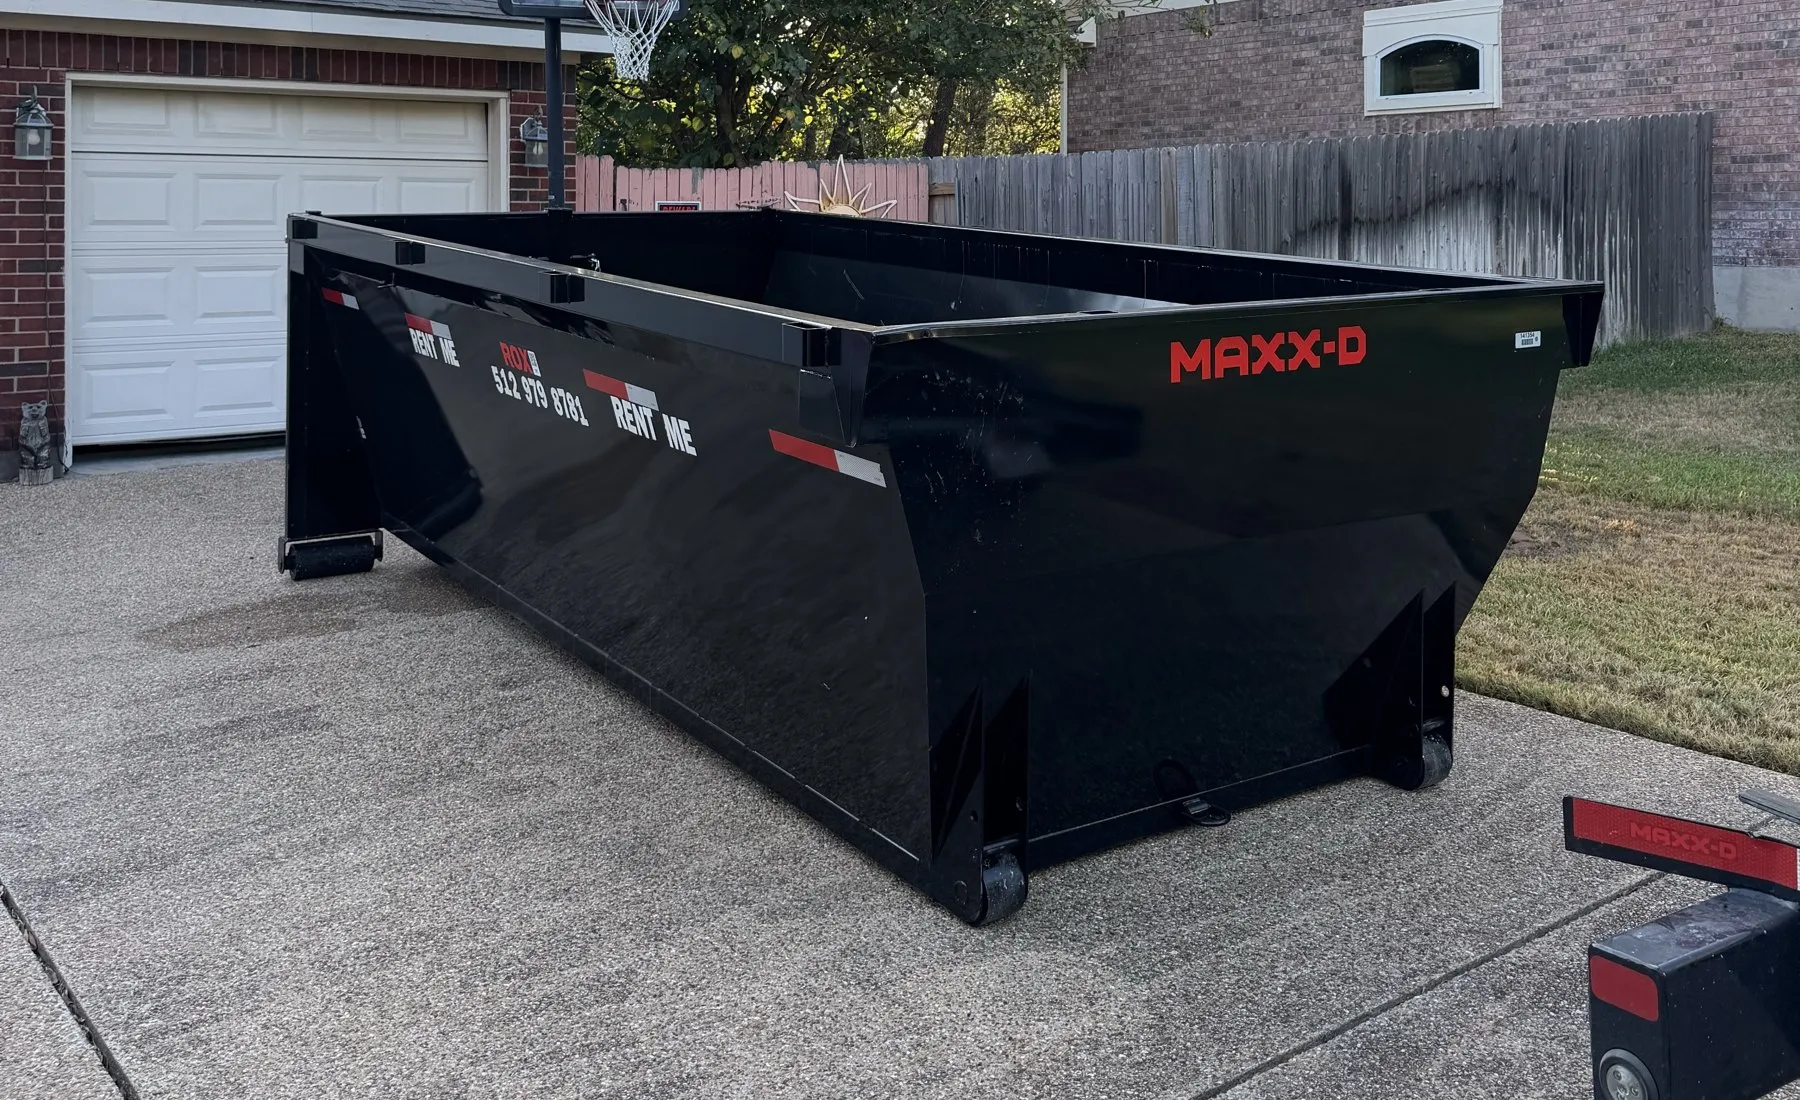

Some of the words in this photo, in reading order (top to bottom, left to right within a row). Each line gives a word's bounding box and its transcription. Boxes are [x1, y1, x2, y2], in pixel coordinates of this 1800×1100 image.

[408, 327, 438, 360] RENT
[439, 337, 461, 368] ME
[499, 341, 534, 375] ROX
[1170, 325, 1367, 384] MAXX-D
[491, 365, 522, 400] 512
[521, 375, 548, 409] 979
[550, 386, 590, 427] 8781
[610, 395, 657, 441] RENT
[662, 413, 698, 457] ME
[1629, 821, 1738, 860] MAXX-D
